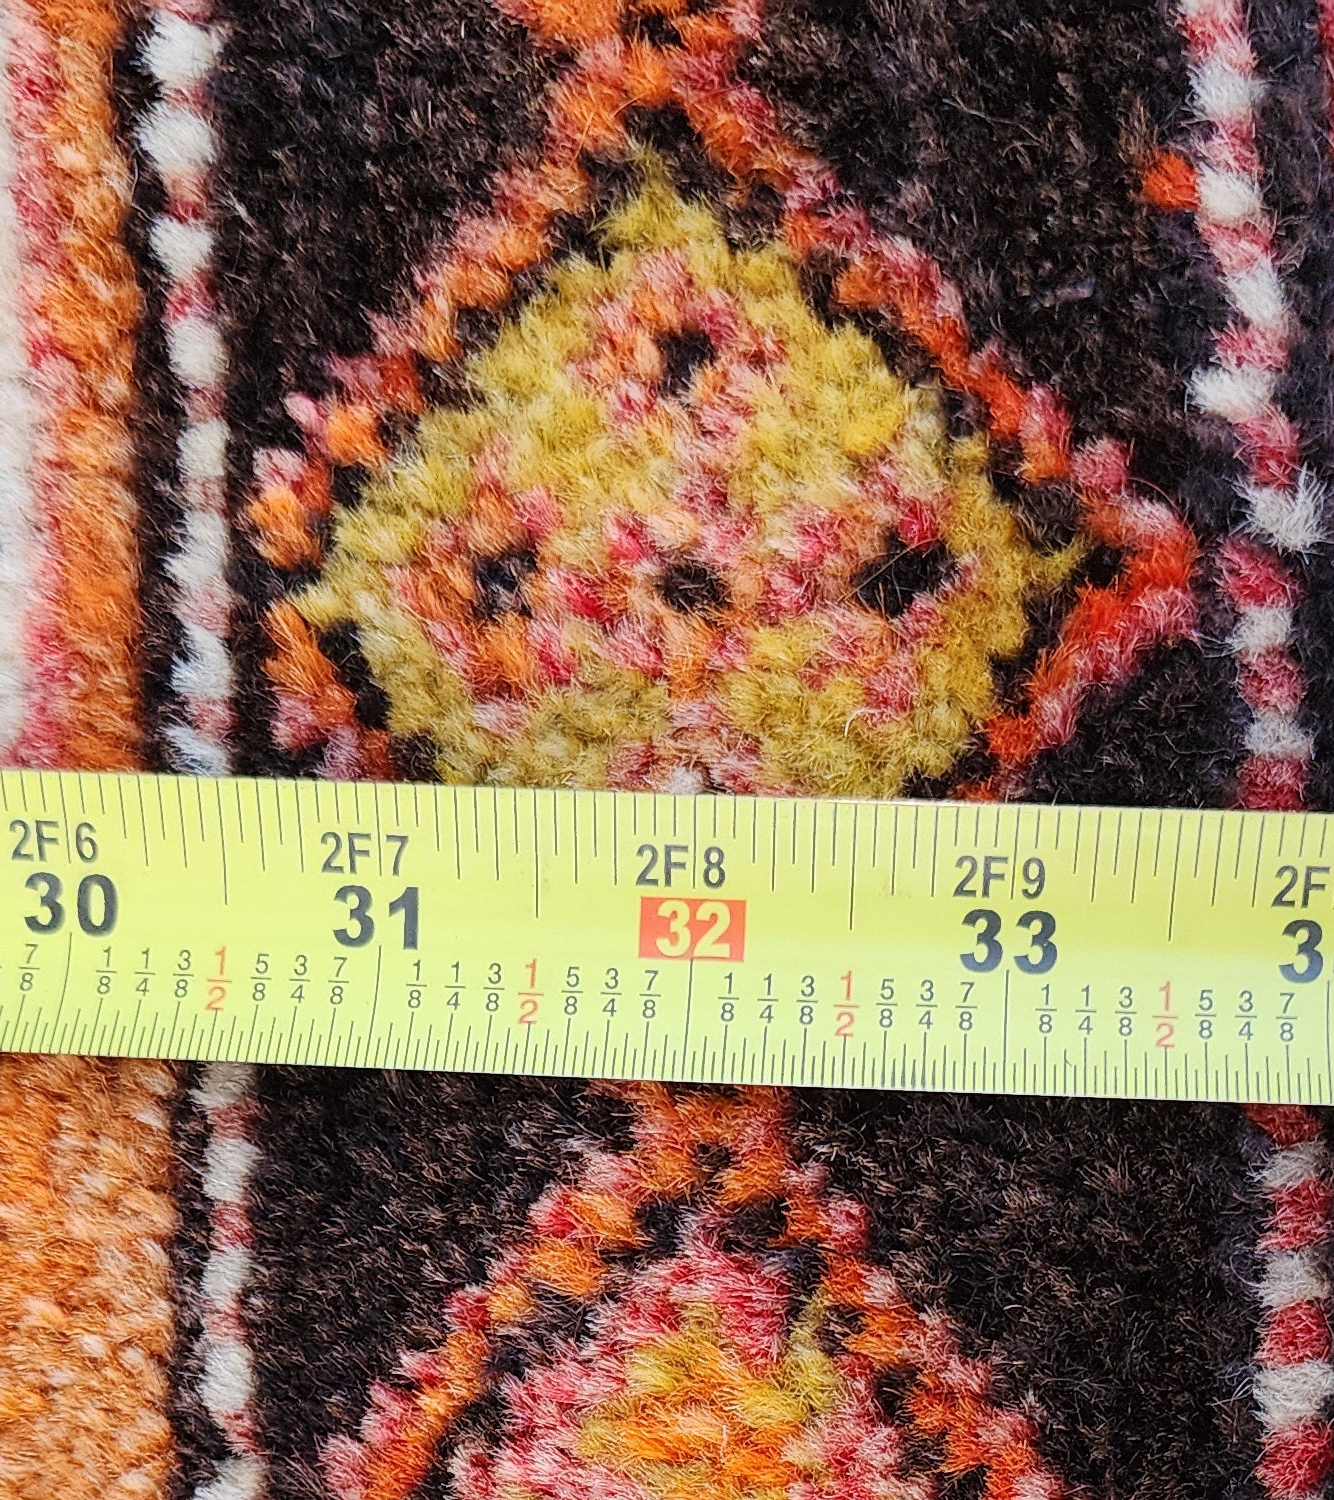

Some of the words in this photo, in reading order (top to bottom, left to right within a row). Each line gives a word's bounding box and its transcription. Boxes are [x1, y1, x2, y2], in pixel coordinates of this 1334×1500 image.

[23, 871, 120, 938] 30
[331, 884, 420, 952] 31
[655, 899, 732, 959] 32
[958, 907, 1058, 976] 33
